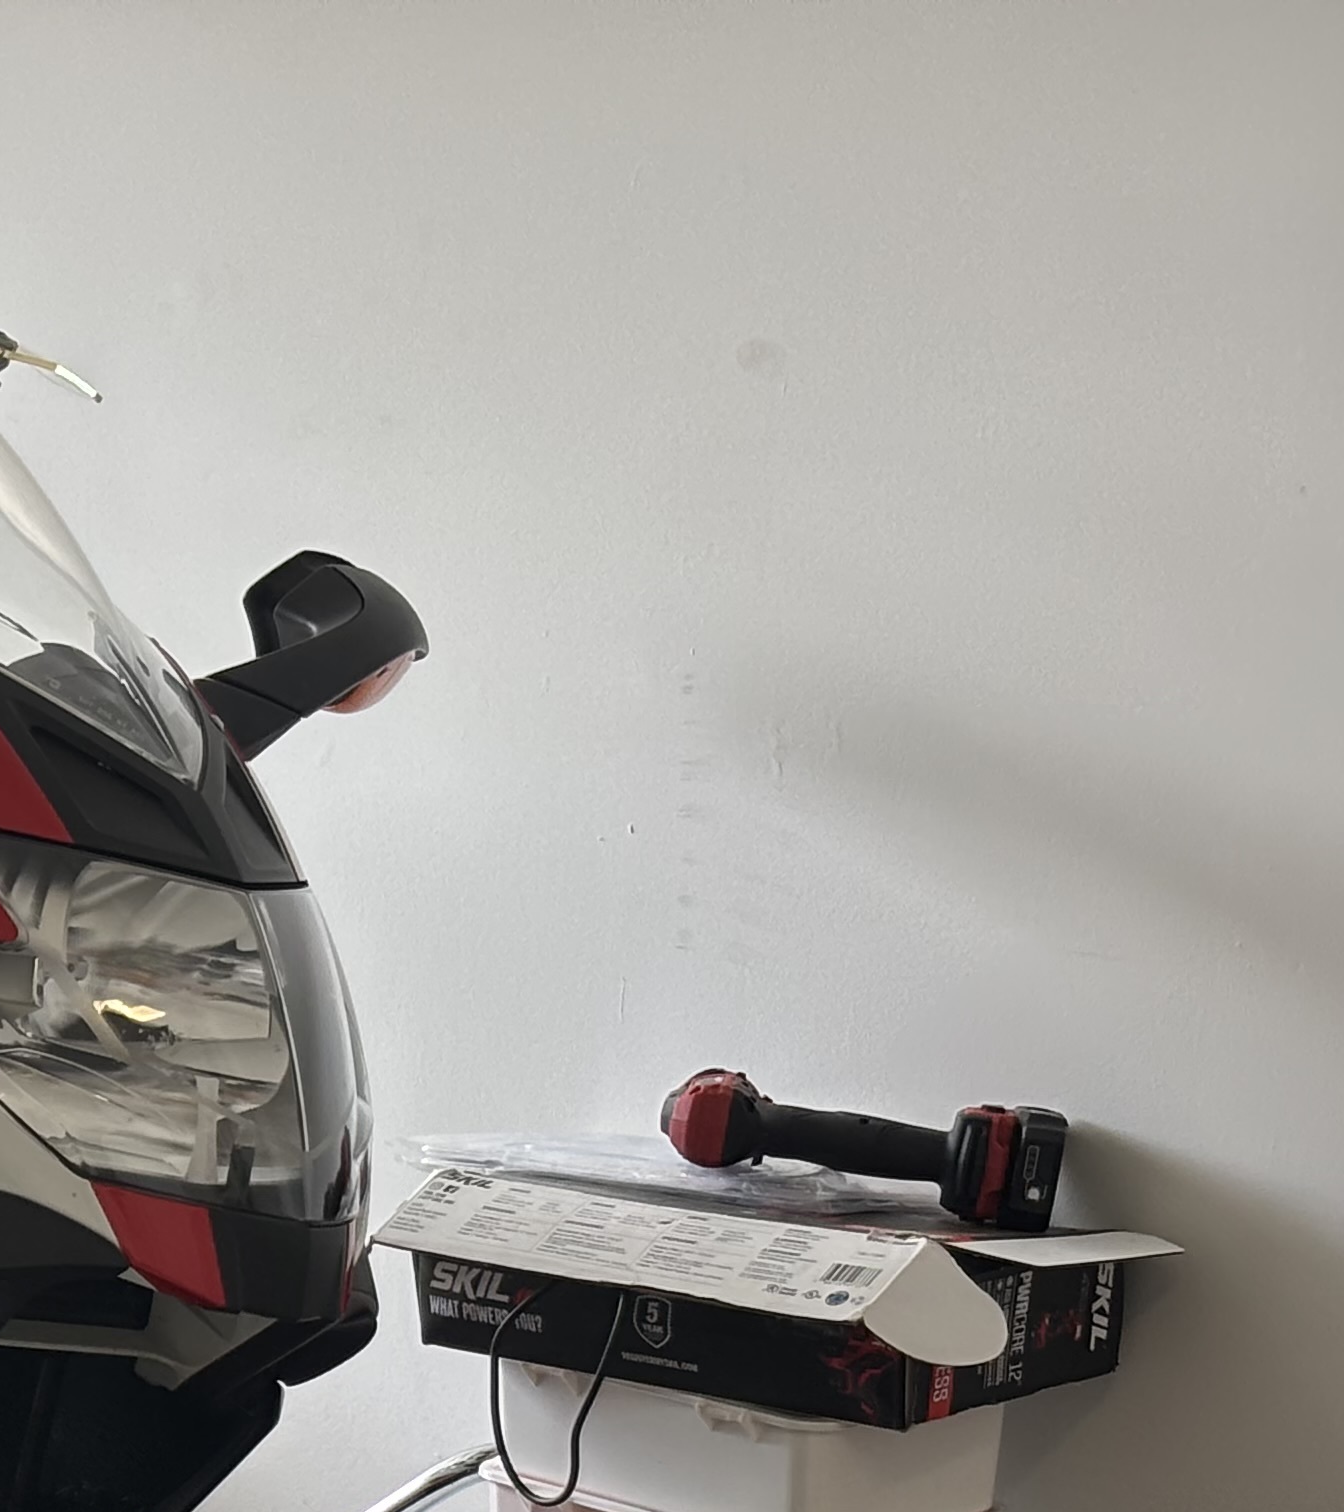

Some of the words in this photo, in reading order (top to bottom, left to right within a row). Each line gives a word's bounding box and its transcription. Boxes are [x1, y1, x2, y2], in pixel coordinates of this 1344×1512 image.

[429, 1260, 511, 1303] SKIL
[429, 1294, 460, 1318] WHAT
[462, 1301, 511, 1328] POWERS
[645, 1301, 659, 1324] 5
[1090, 1262, 1114, 1351] SKIL
